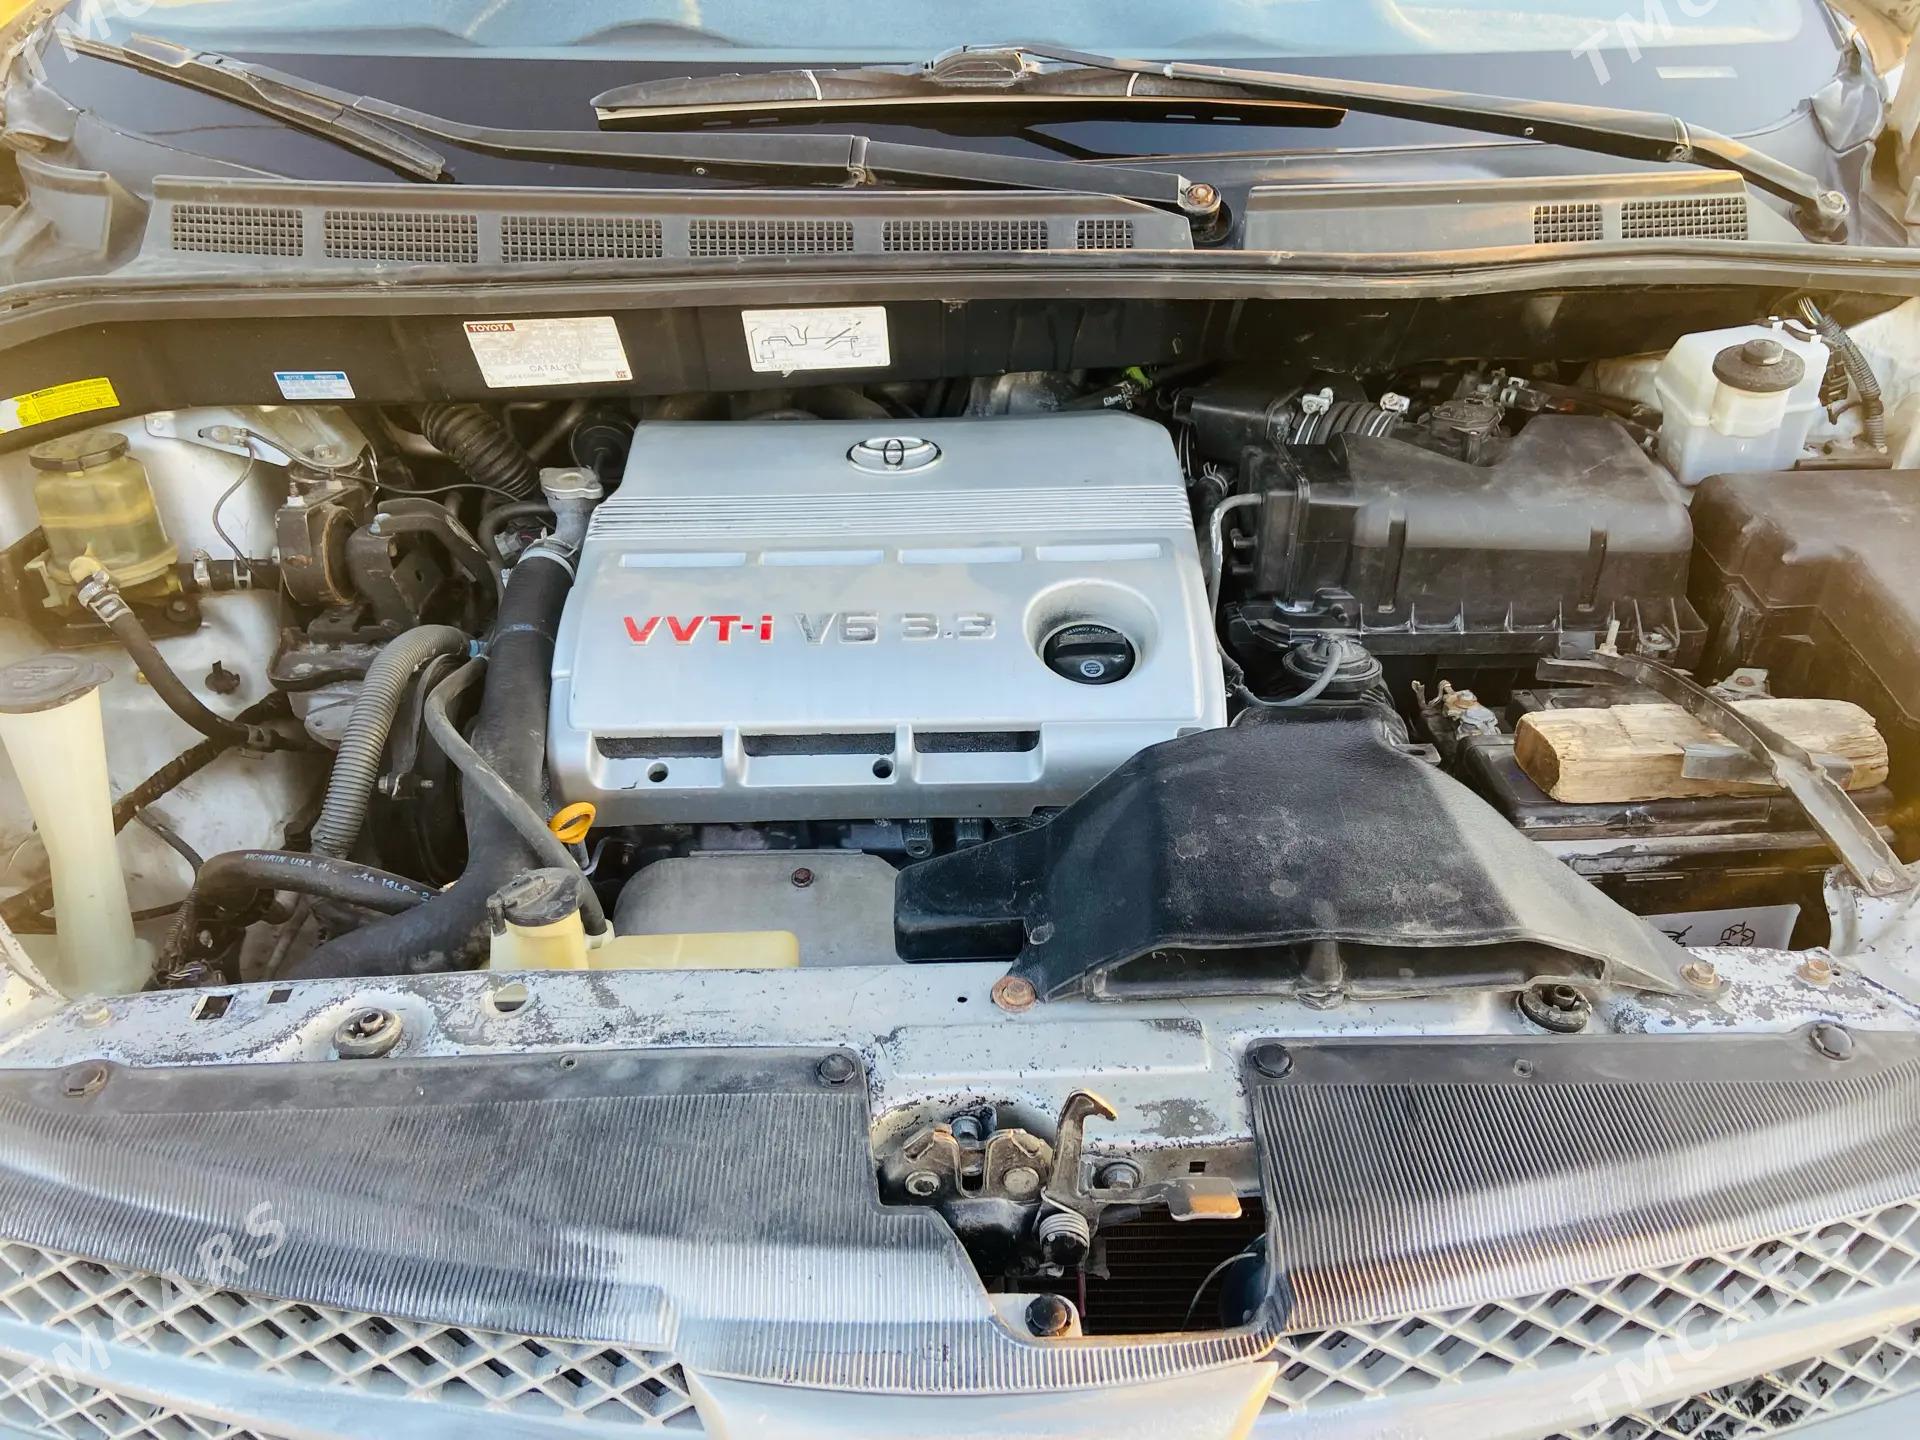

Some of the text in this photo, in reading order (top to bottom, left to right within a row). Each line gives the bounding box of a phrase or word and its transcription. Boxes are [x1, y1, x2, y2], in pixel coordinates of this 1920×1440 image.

[469, 323, 513, 332] TOYOTA
[622, 611, 997, 646] VVT-i V6 3.3
[290, 857, 312, 868] USA
